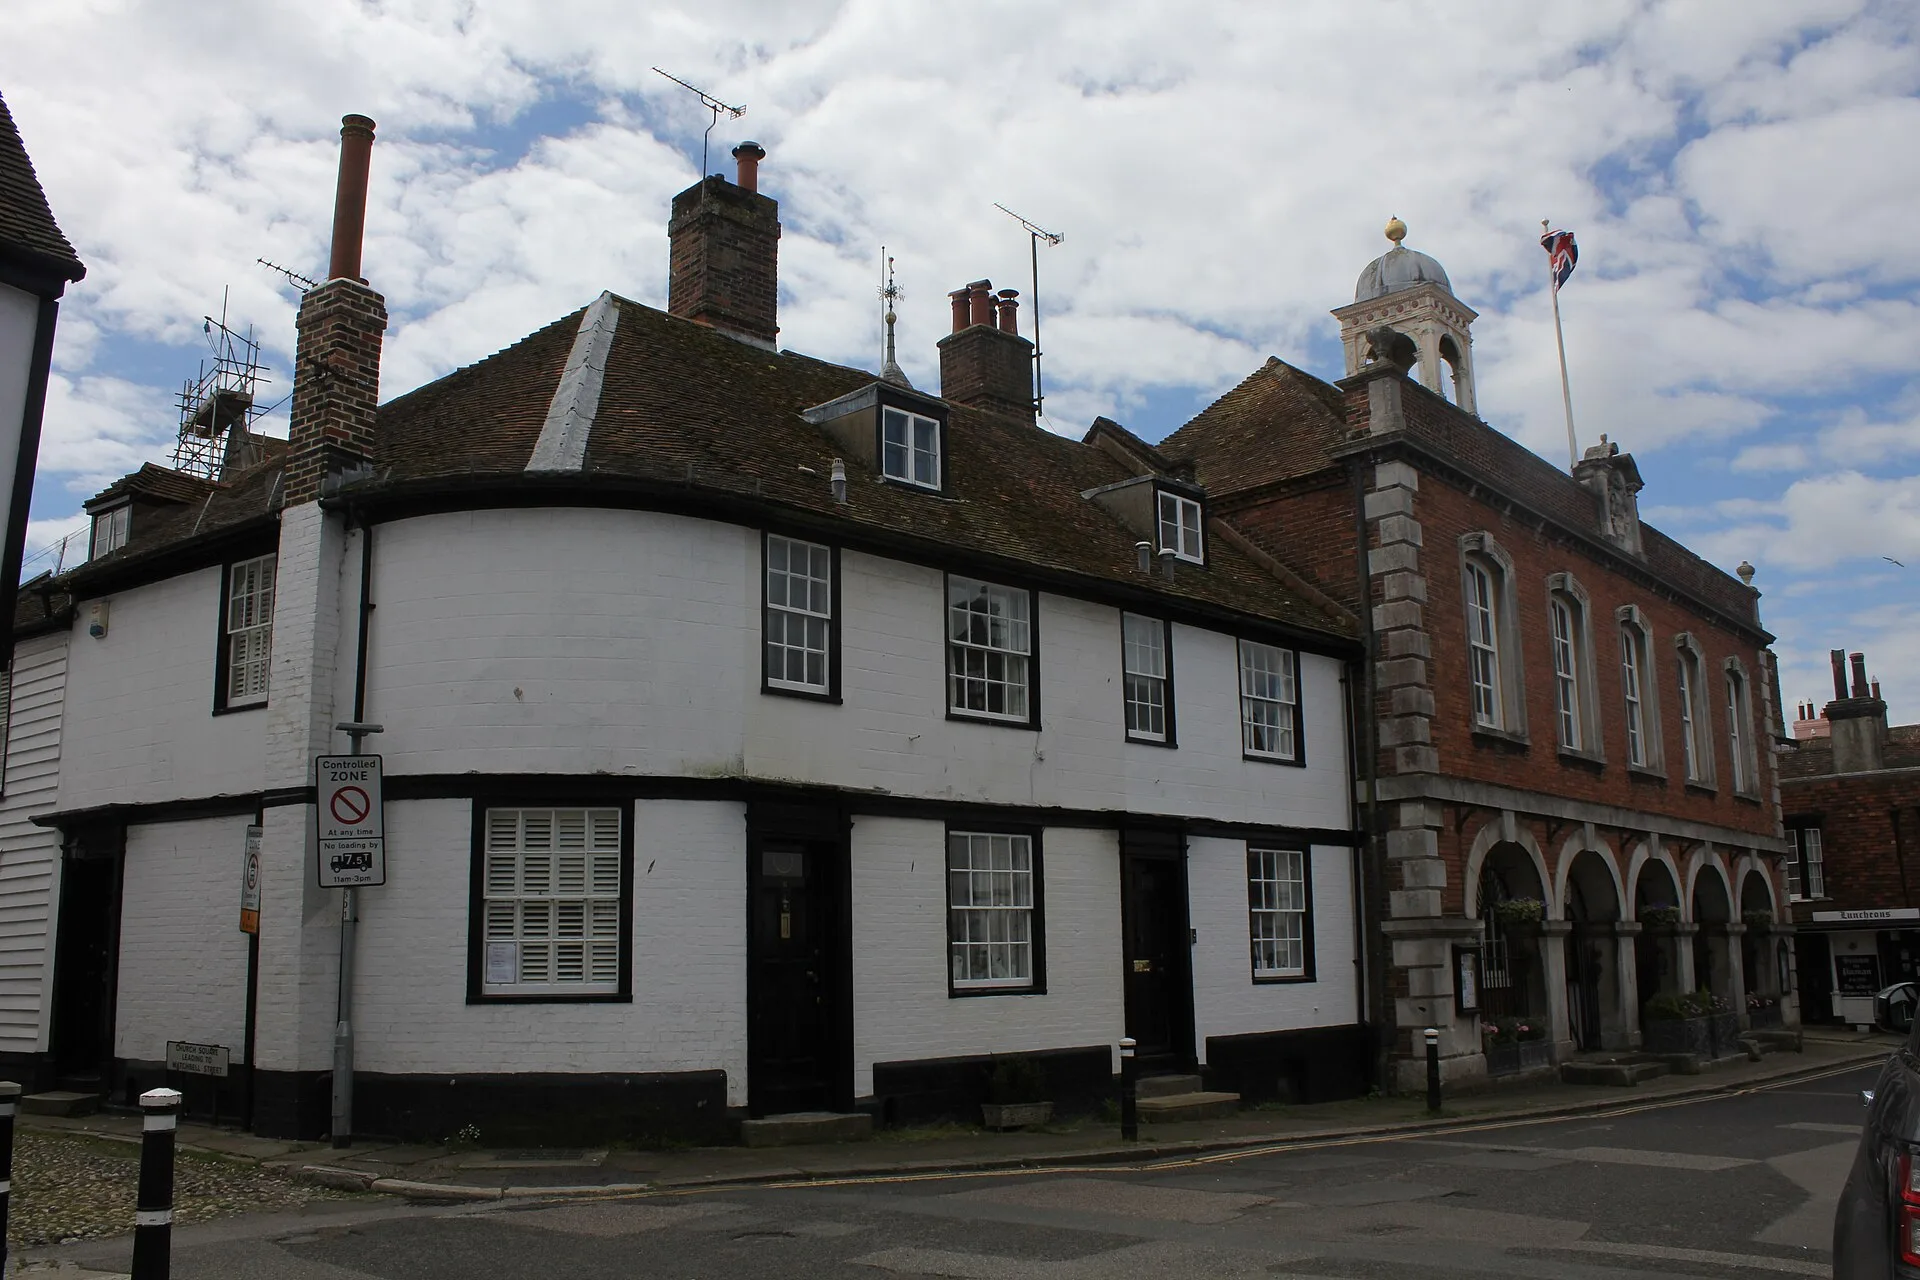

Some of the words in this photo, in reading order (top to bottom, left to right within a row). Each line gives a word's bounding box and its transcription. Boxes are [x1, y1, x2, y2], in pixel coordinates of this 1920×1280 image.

[323, 760, 376, 769] Controlled
[331, 771, 368, 781] ZONE
[334, 875, 371, 883] 11am-3pm
[1840, 910, 1891, 919] Luncheons
[198, 1047, 218, 1056] SQUARE
[203, 1065, 222, 1074] STREET
